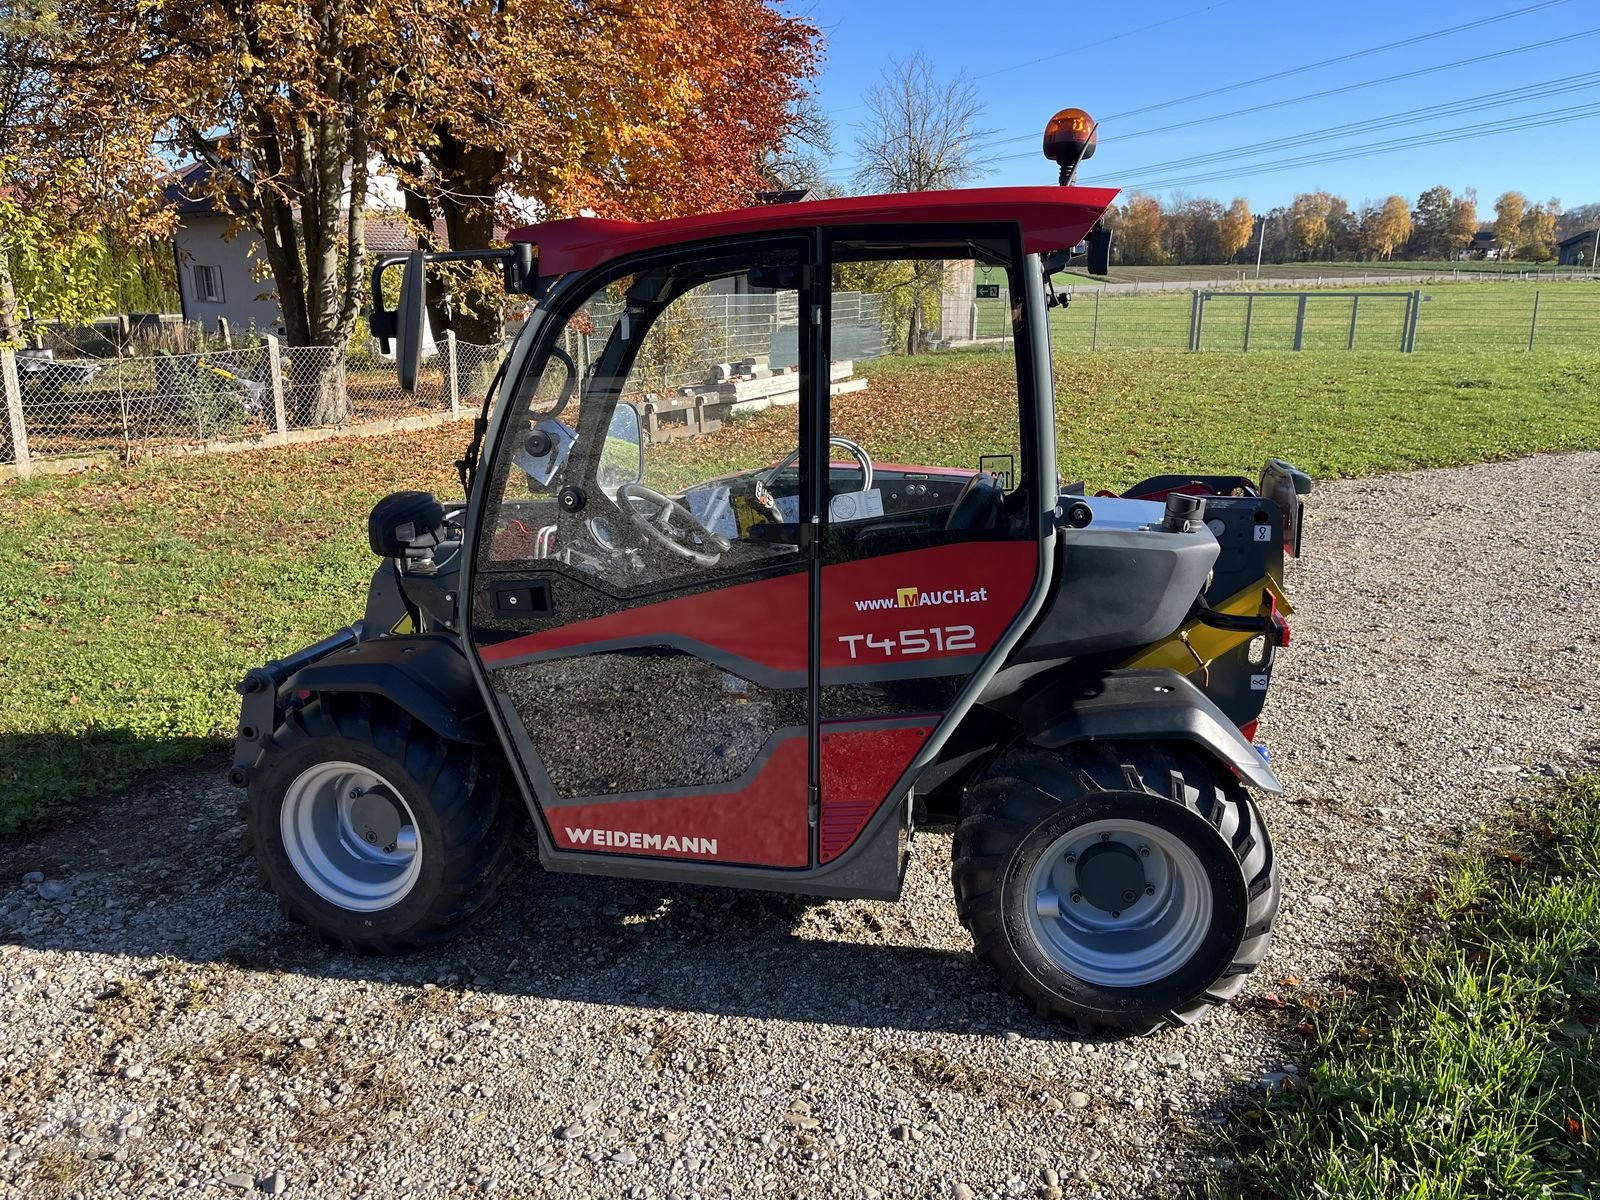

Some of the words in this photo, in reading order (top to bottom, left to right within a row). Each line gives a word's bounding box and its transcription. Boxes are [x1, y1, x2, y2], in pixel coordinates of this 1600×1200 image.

[855, 587, 988, 611] www.MAUCH.at
[838, 624, 977, 659] T4512
[565, 827, 718, 855] WEIDEMANN
